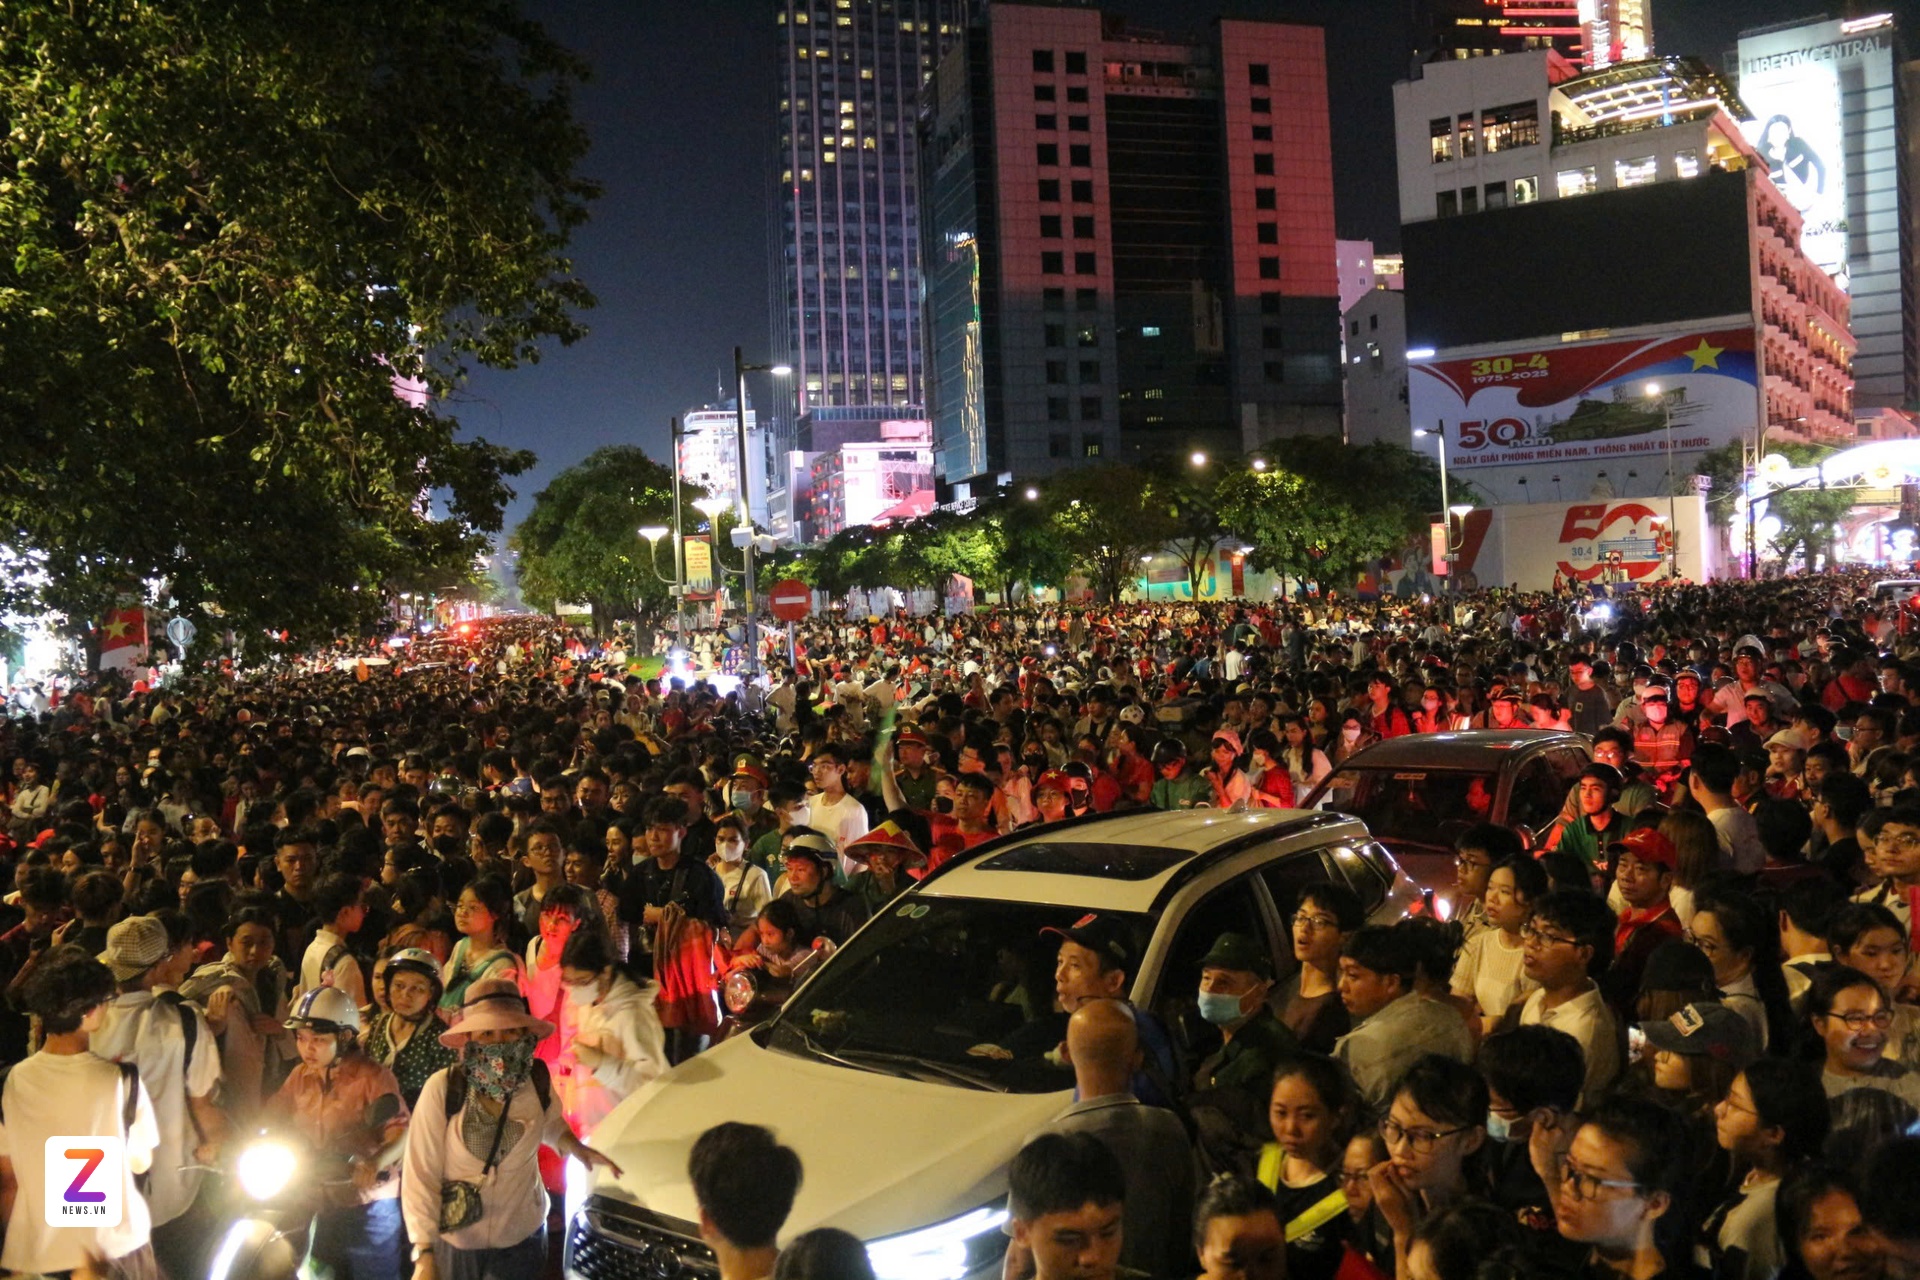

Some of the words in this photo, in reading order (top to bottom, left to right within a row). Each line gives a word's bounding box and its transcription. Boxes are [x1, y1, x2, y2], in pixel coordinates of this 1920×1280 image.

[1748, 49, 1807, 74] LIBERTY
[1809, 36, 1886, 62] CENTRAL
[1471, 353, 1550, 377] 30-4
[1458, 417, 1527, 450] 50
[1571, 546, 1593, 557] 30.4
